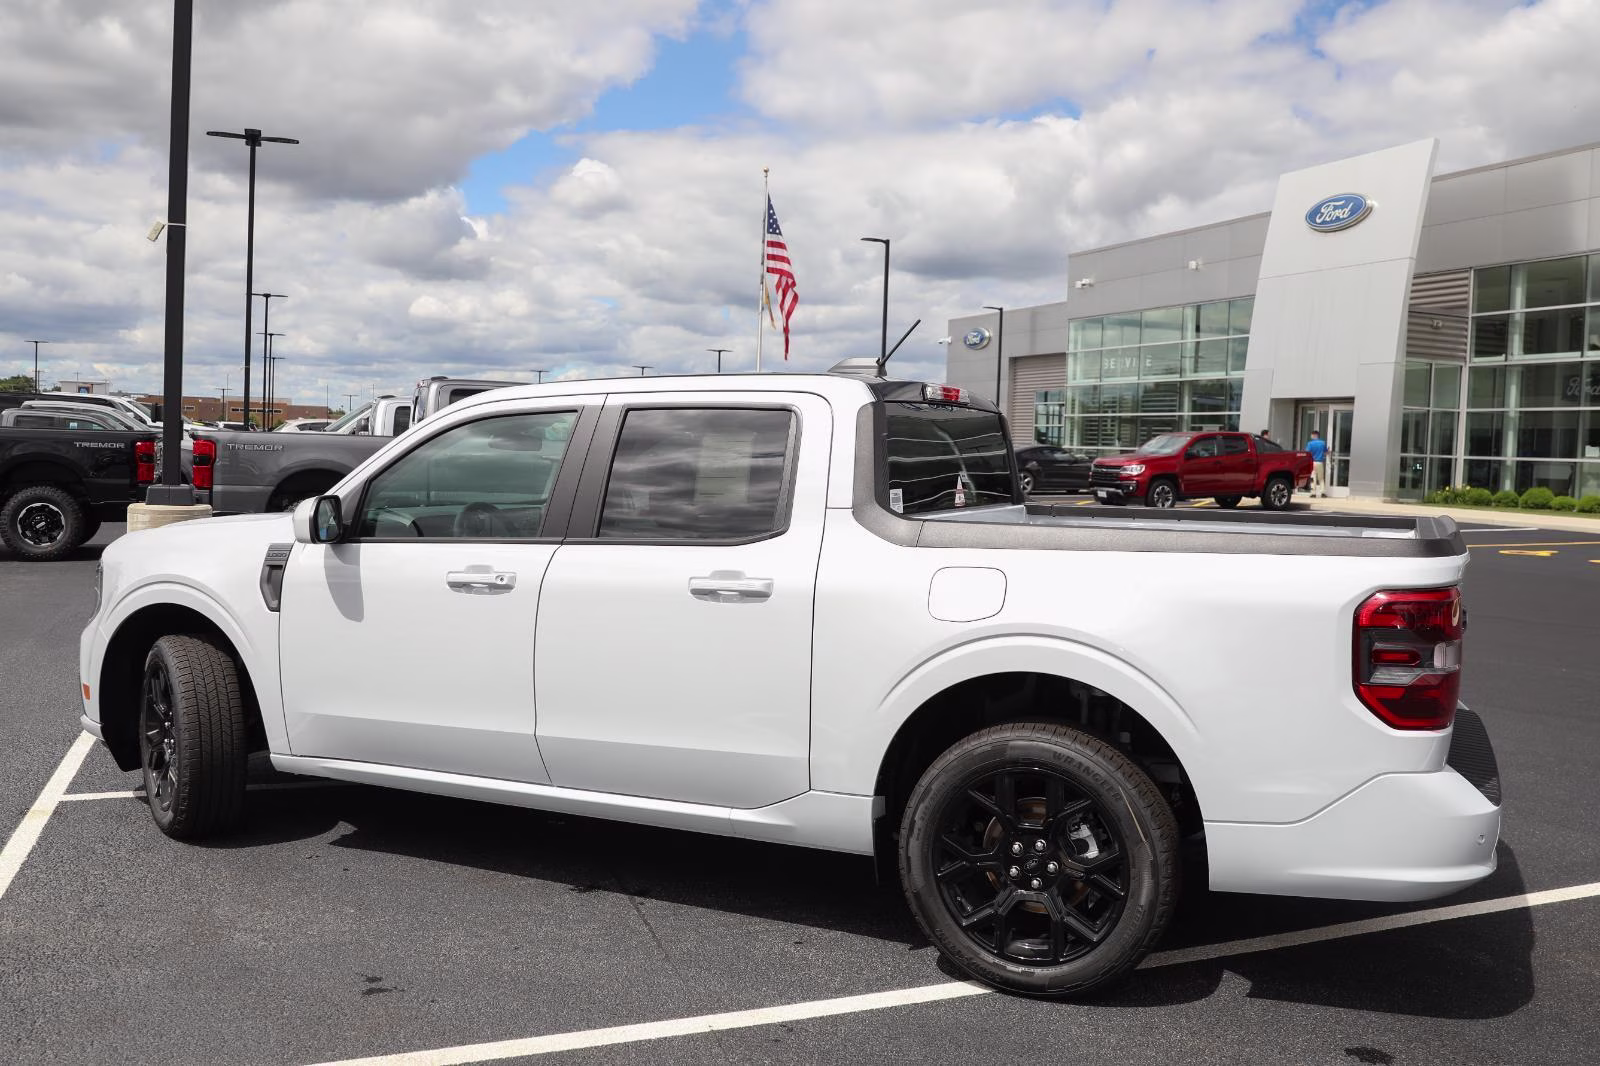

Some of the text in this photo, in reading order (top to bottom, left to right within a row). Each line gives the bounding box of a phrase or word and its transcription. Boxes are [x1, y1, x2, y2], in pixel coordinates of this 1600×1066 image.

[1315, 200, 1354, 224] Ford
[966, 331, 982, 345] Ford
[1104, 355, 1153, 369] SEVIE
[74, 441, 125, 449] TREMOR
[227, 443, 283, 451] TREMOR
